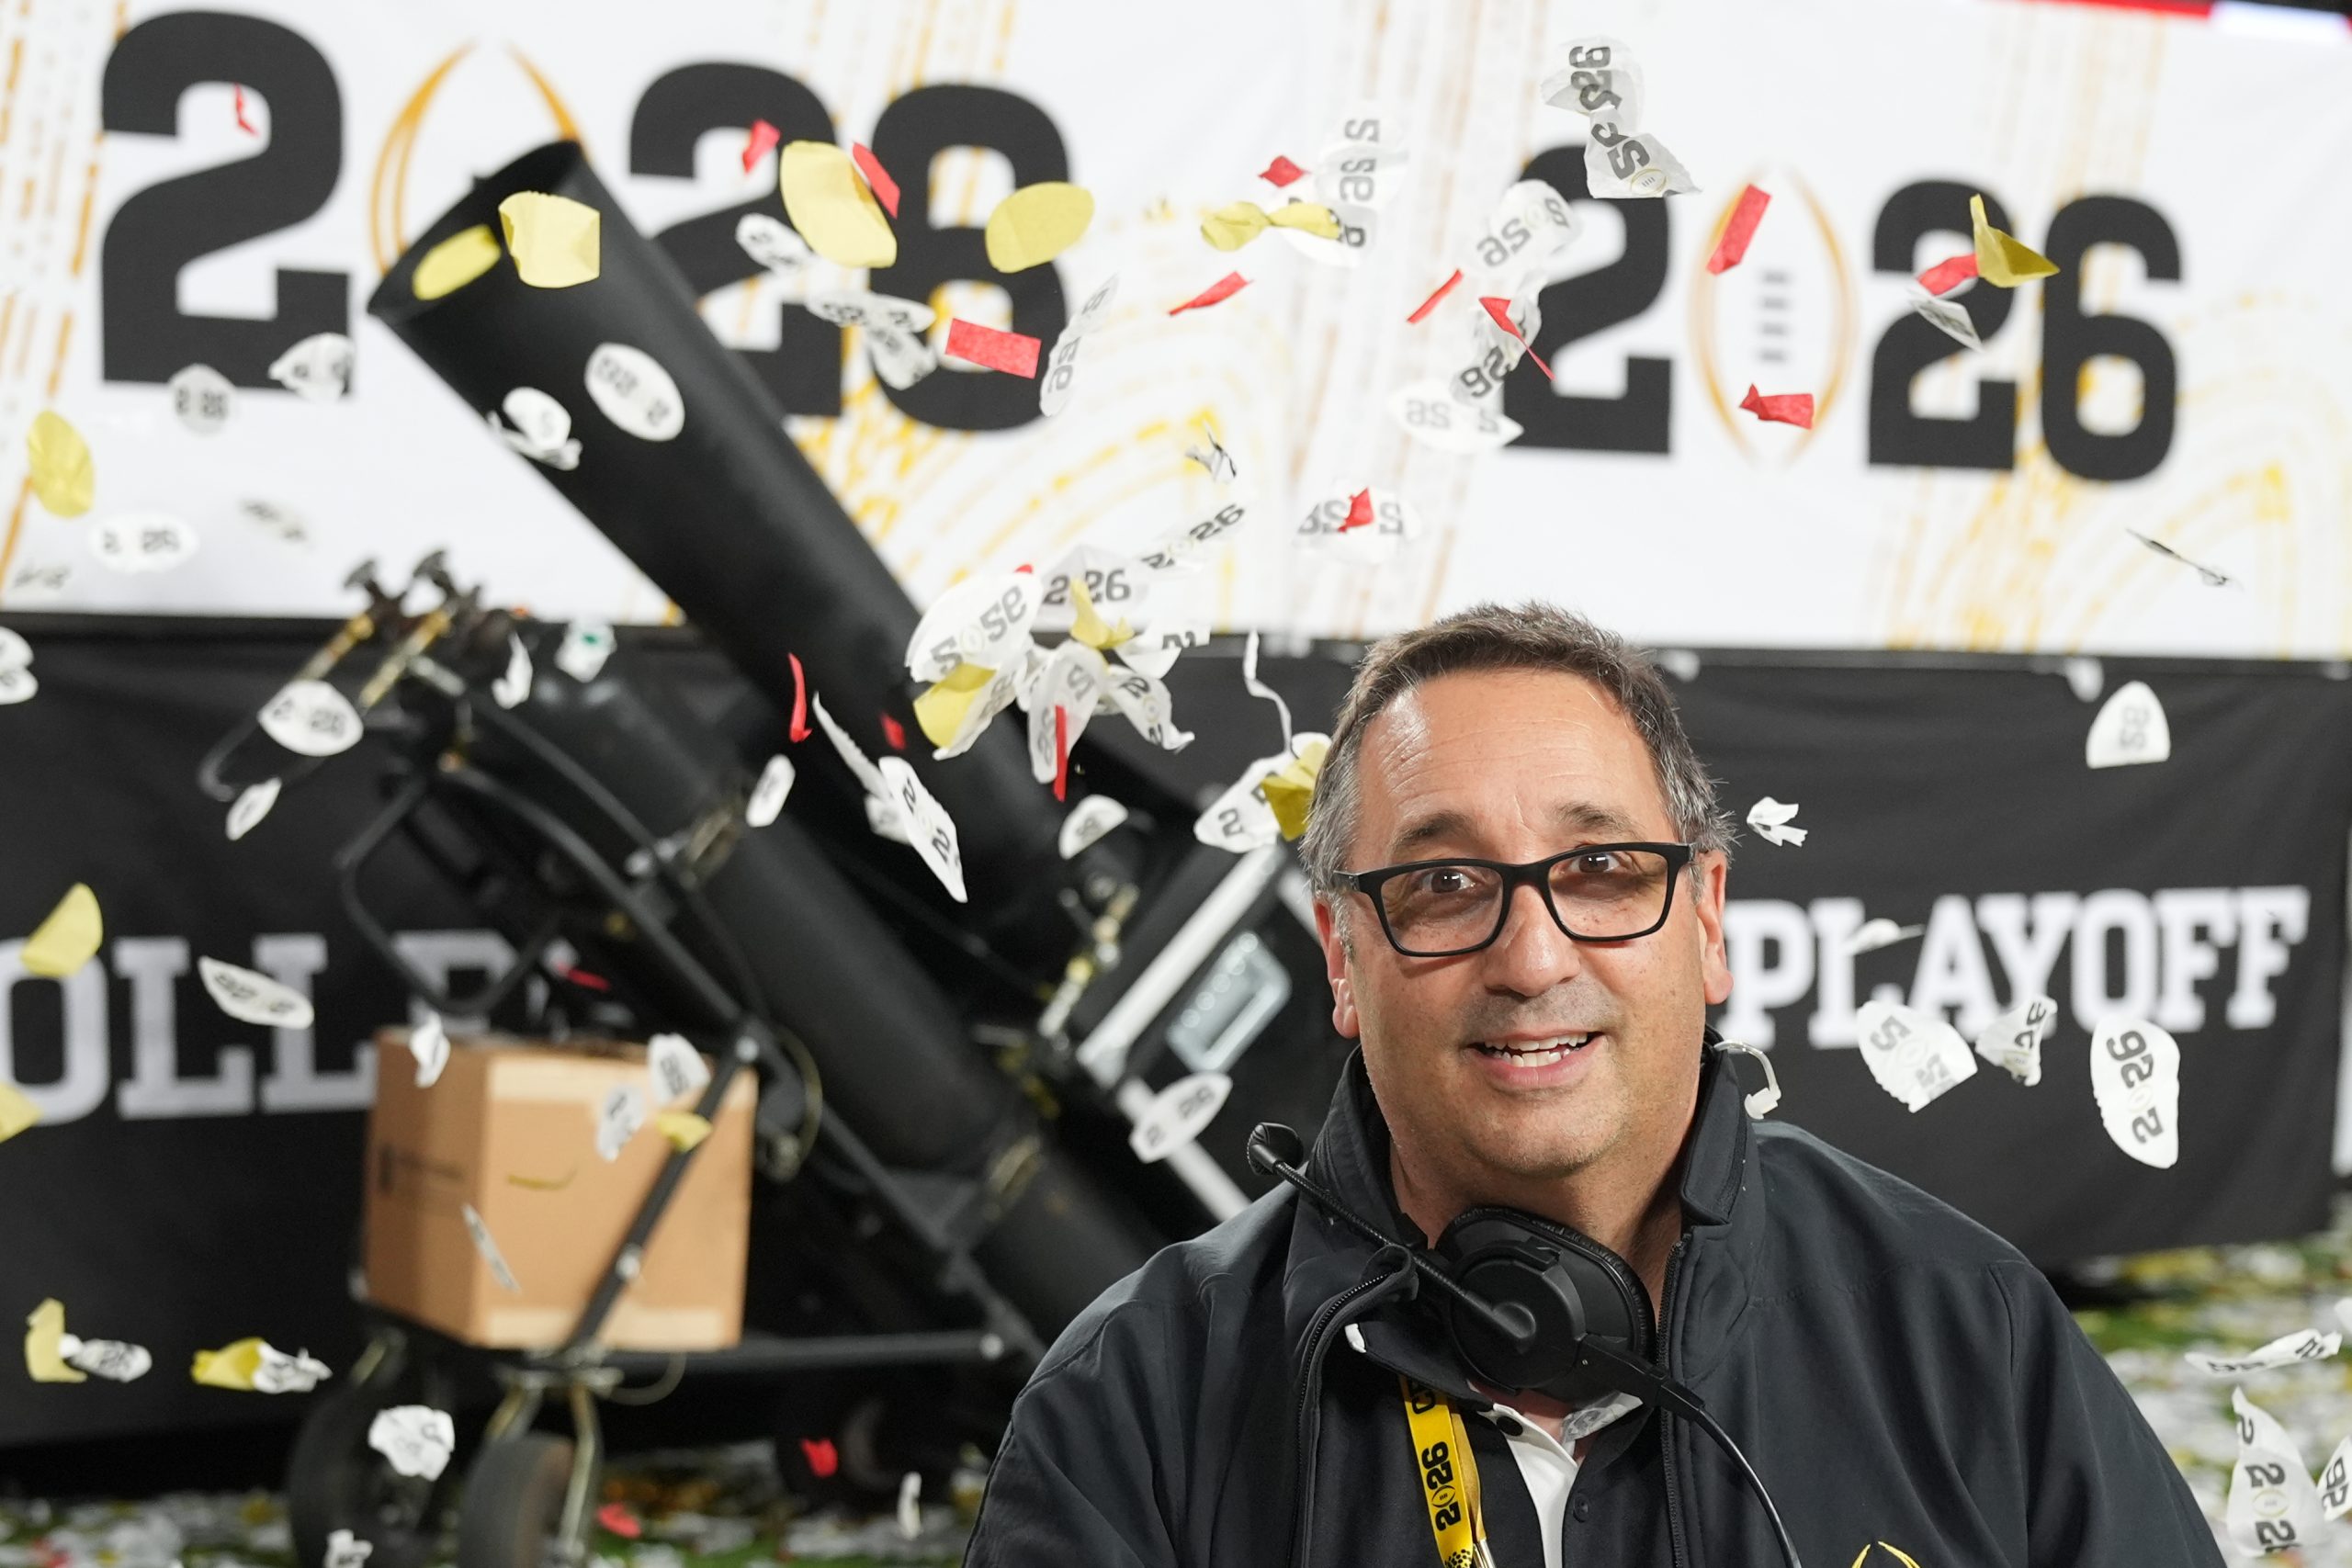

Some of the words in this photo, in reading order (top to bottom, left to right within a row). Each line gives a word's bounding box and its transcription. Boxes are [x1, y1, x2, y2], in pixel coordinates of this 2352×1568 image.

[1043, 569, 1132, 605] 226
[1716, 885, 2310, 1054] PLAYOFF
[1421, 1440, 1462, 1532] 2026
